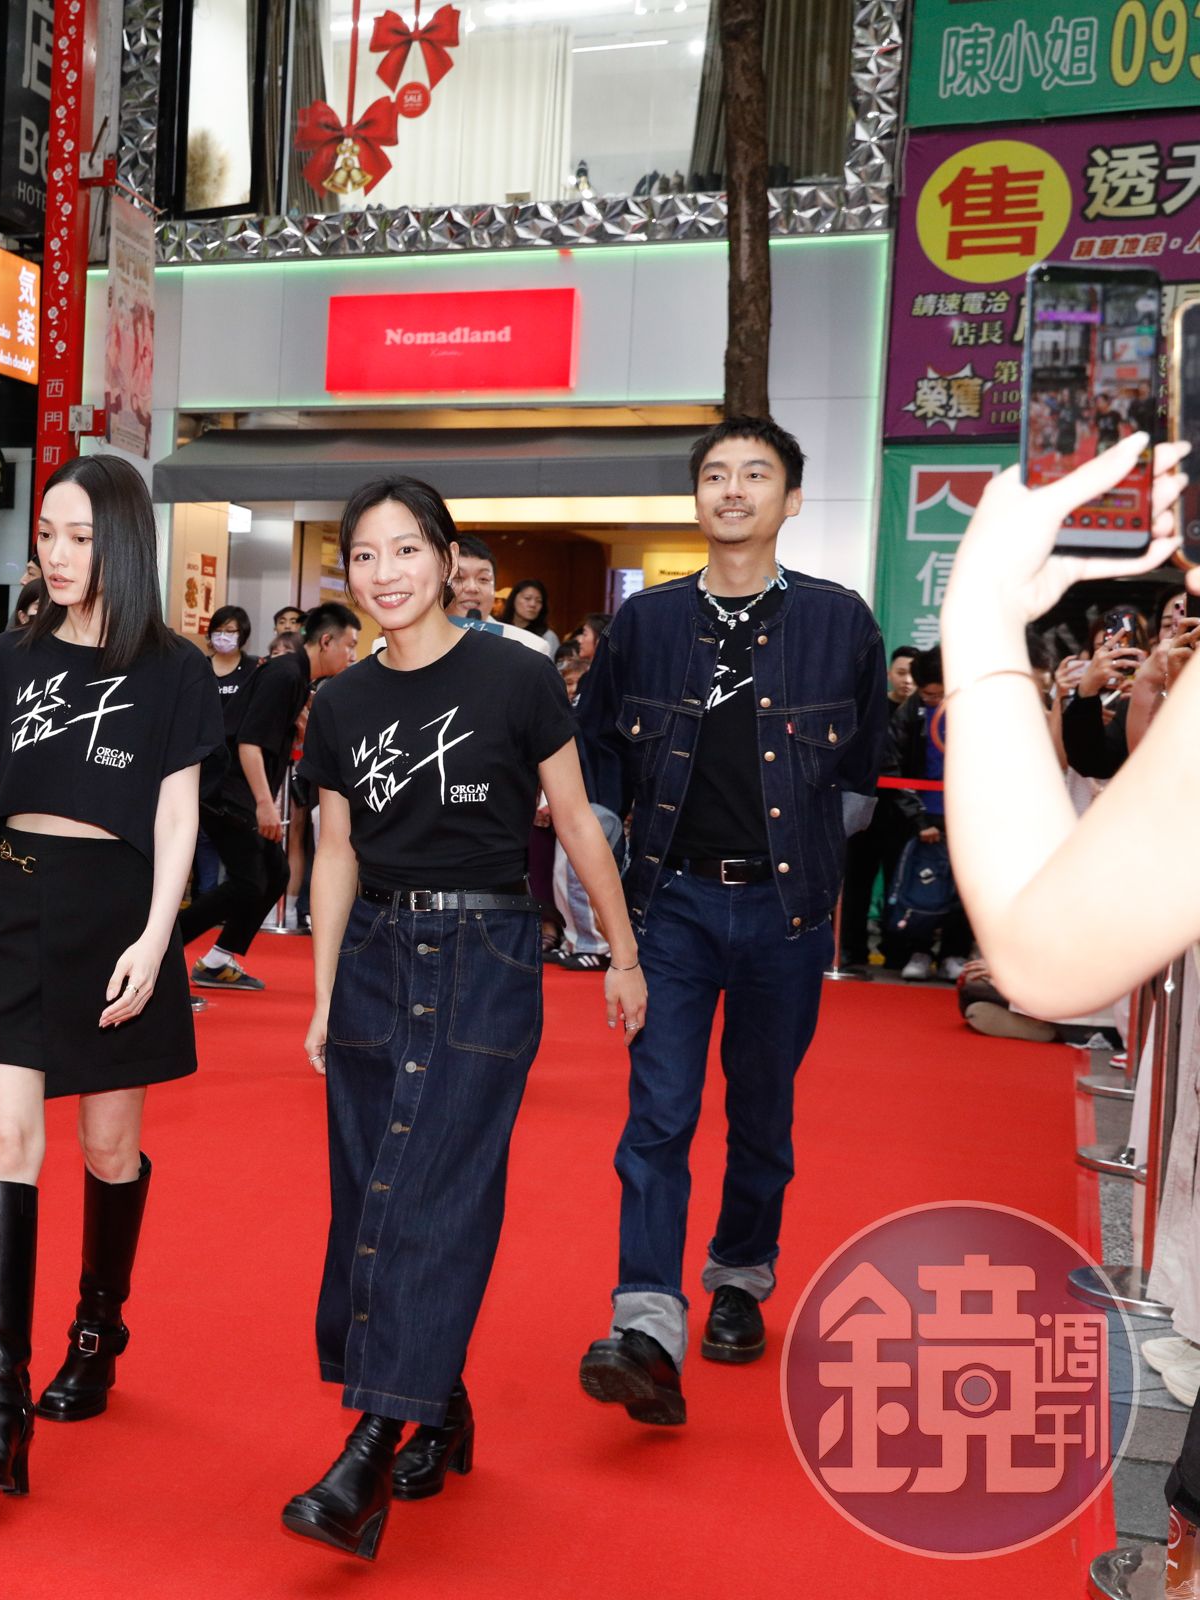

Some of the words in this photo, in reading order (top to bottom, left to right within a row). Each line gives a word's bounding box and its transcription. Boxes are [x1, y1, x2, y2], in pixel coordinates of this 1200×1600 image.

[1110, 0, 1200, 87] 09
[939, 16, 1098, 99] 陳小姐
[939, 165, 1045, 261] 售
[385, 326, 511, 346] Nomadland
[952, 320, 1004, 346] 店長
[915, 376, 984, 419] 榮獲
[42, 378, 64, 466] 西門町
[93, 755, 127, 769] CHILD
[96, 746, 135, 763] ORGAN
[449, 782, 490, 796] ORGAN
[450, 793, 487, 804] CHILD
